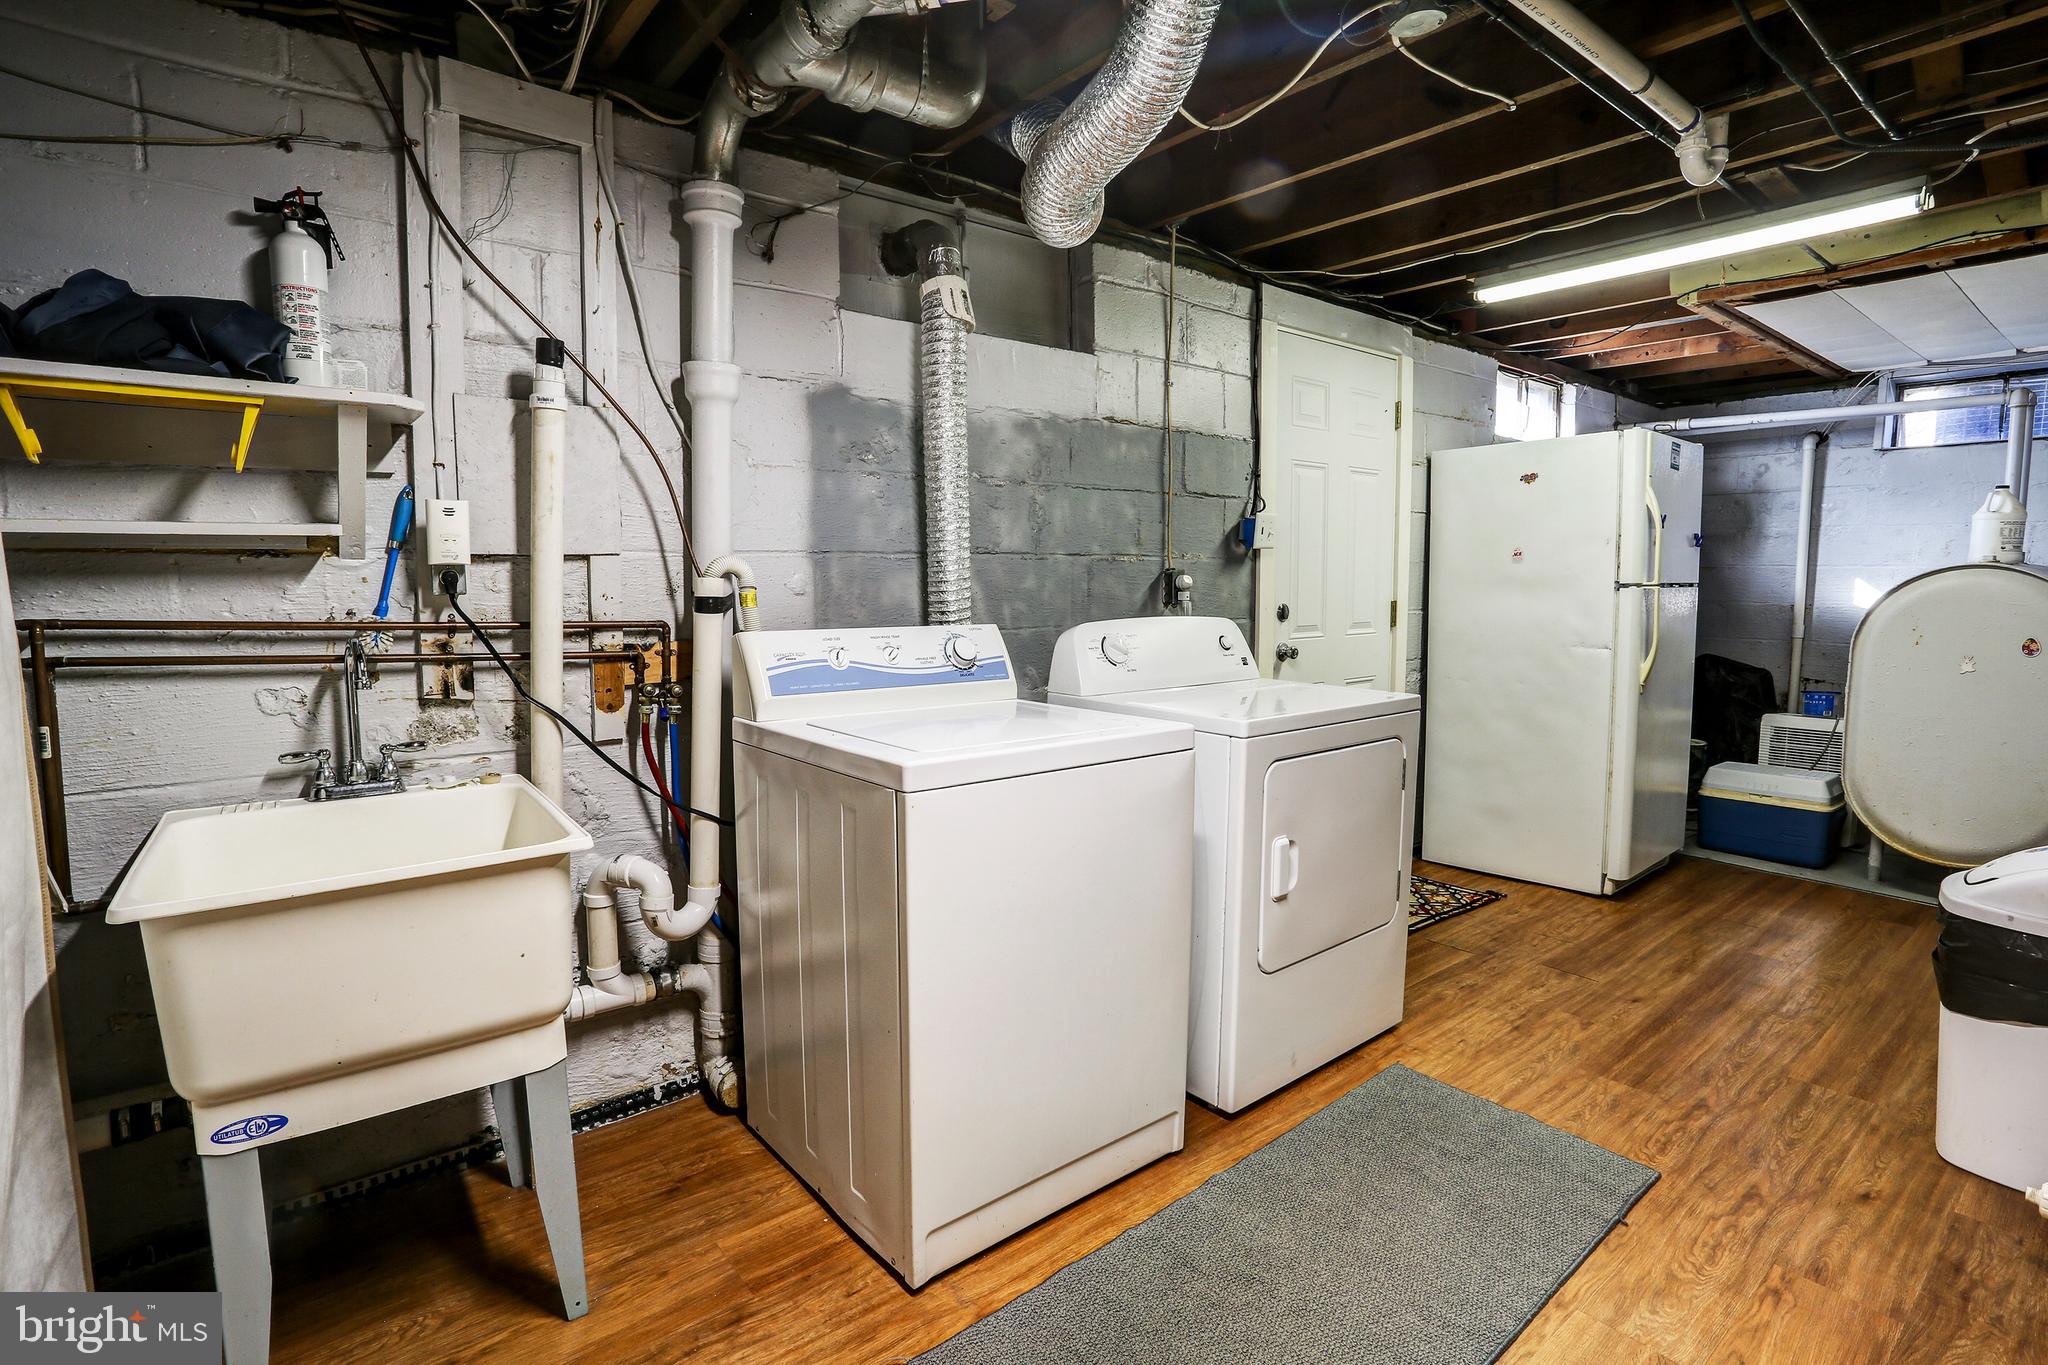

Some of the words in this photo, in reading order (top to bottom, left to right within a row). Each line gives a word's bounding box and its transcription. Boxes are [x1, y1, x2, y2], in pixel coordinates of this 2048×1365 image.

[1547, 18, 1600, 59] CHARLOTTE
[280, 284, 319, 294] INSTRUCTIONS
[212, 1127, 245, 1141] UTILATUB
